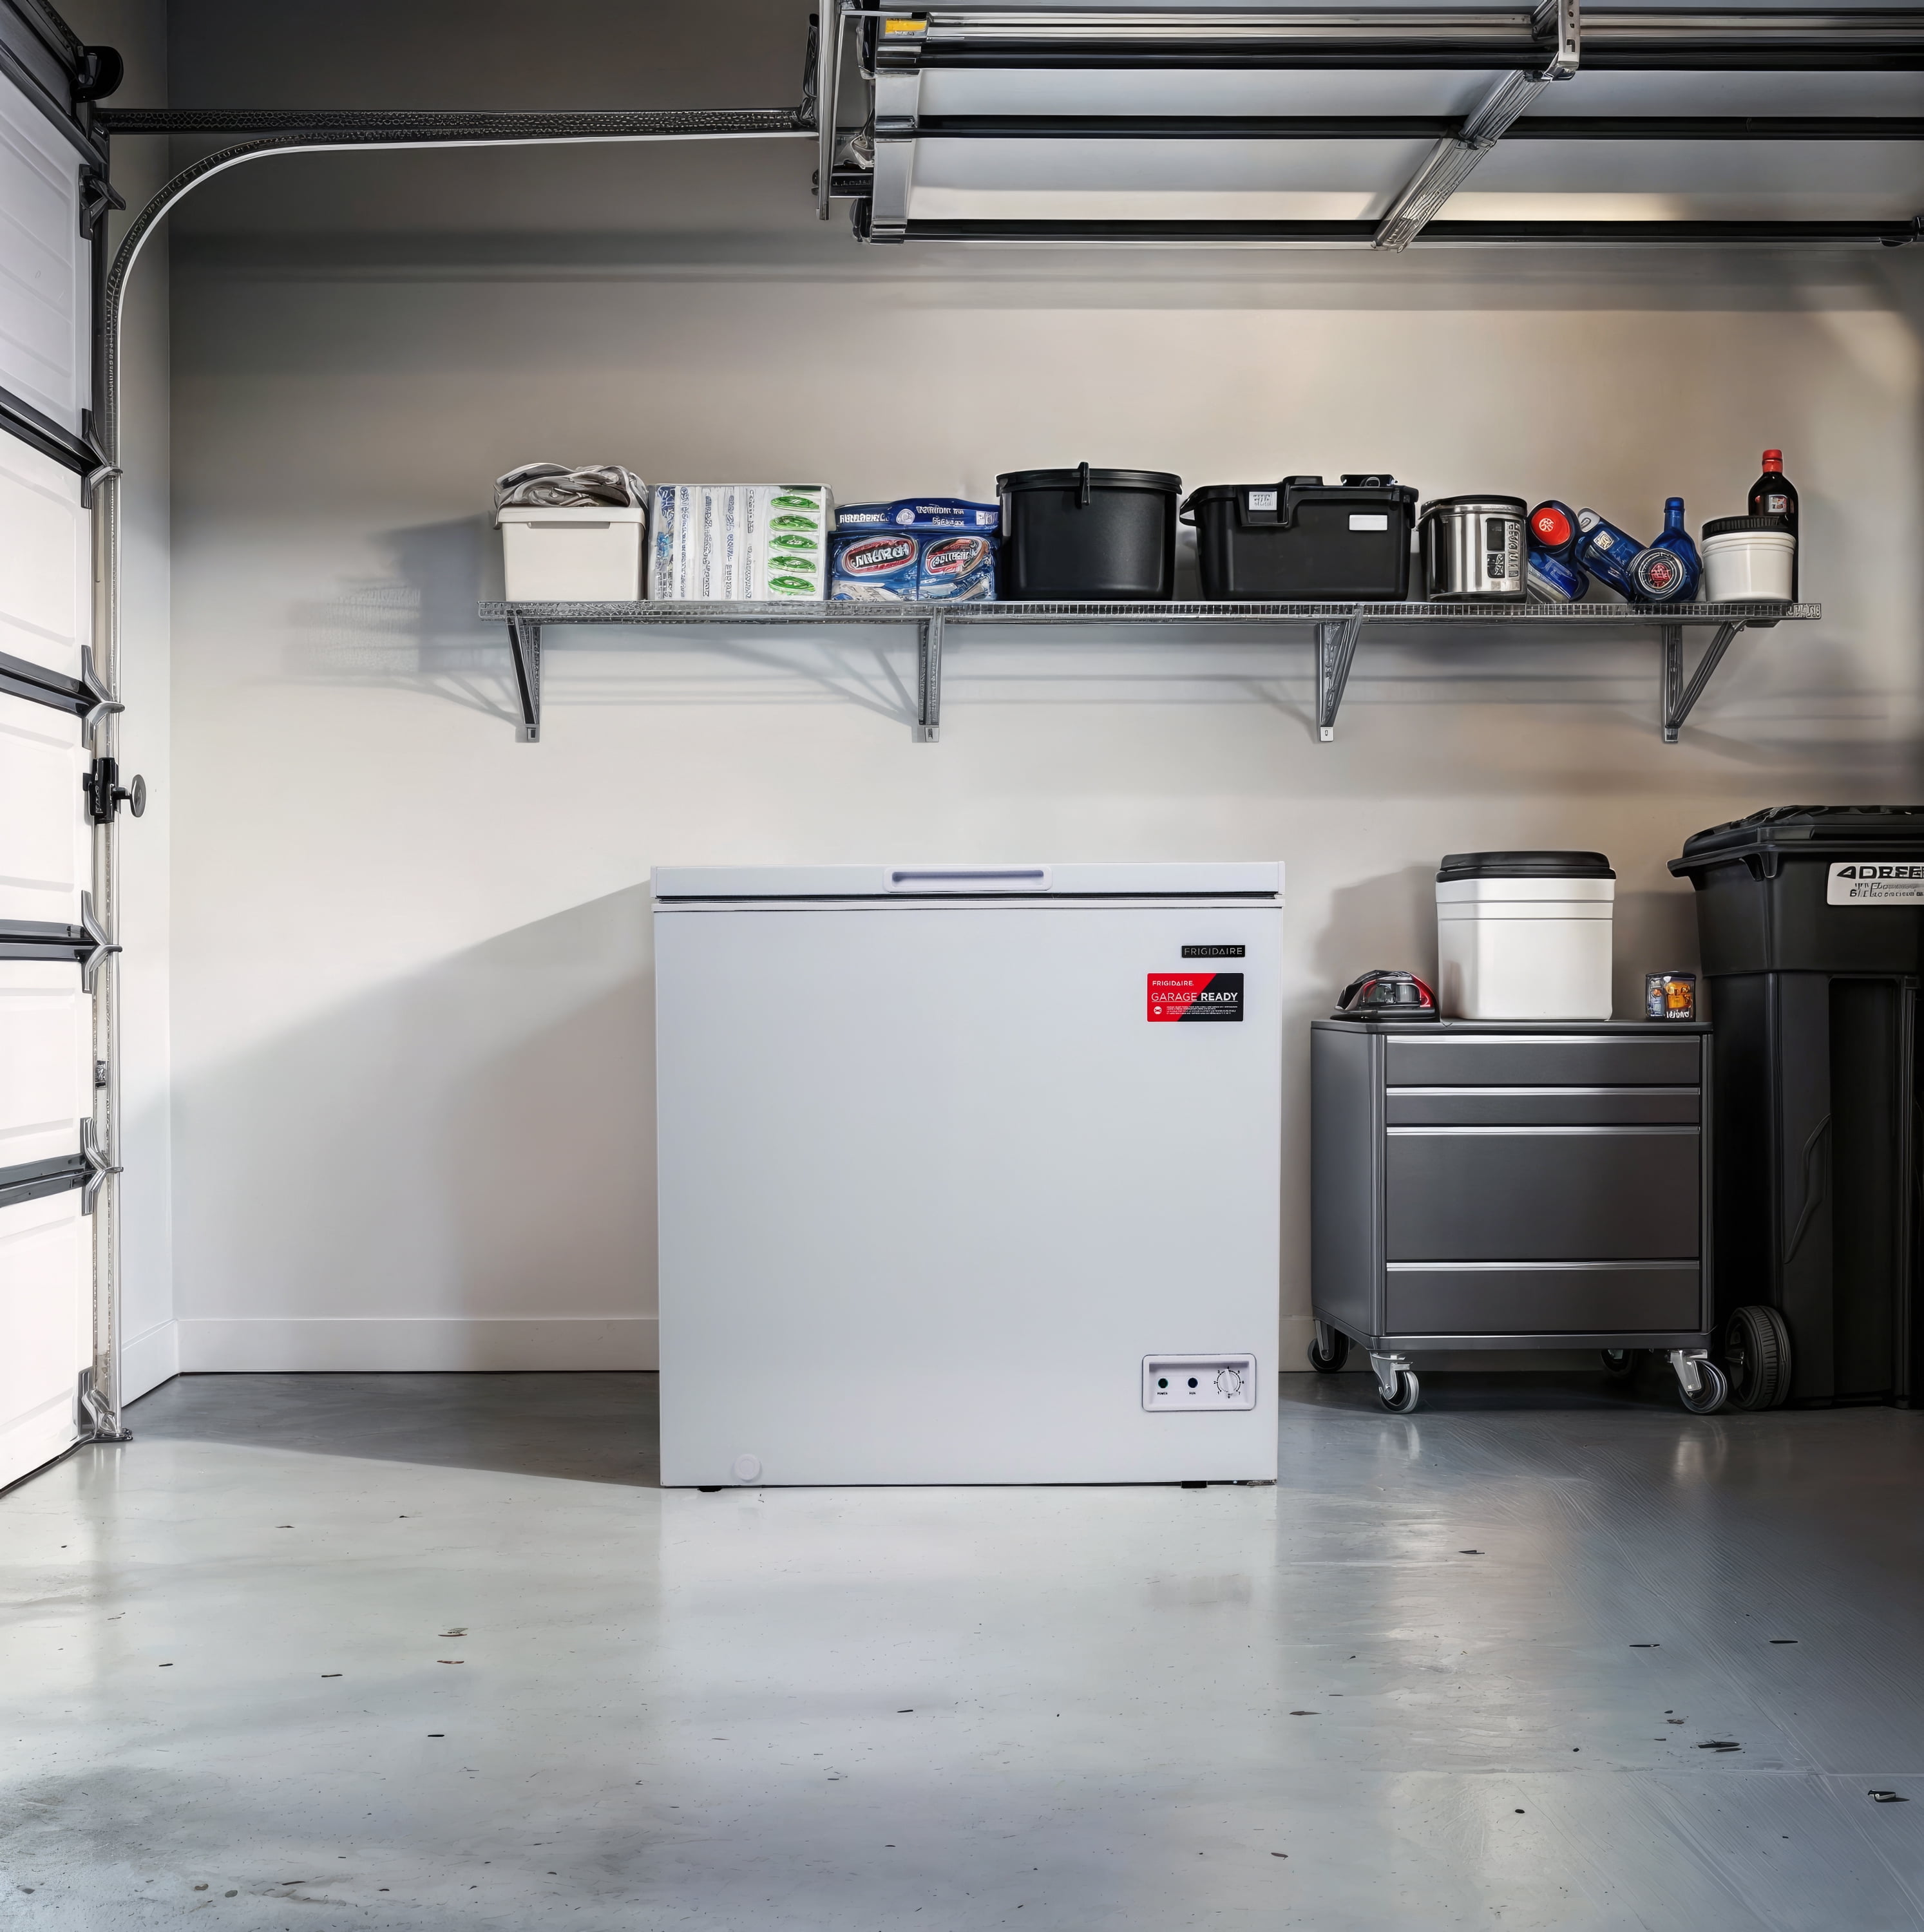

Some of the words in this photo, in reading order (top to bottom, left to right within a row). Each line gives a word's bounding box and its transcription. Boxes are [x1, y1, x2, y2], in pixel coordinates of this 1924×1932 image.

[1184, 947, 1243, 956] FRIGIDAIRE
[1151, 992, 1197, 1001] GARAGE
[1201, 992, 1238, 1001] READY
